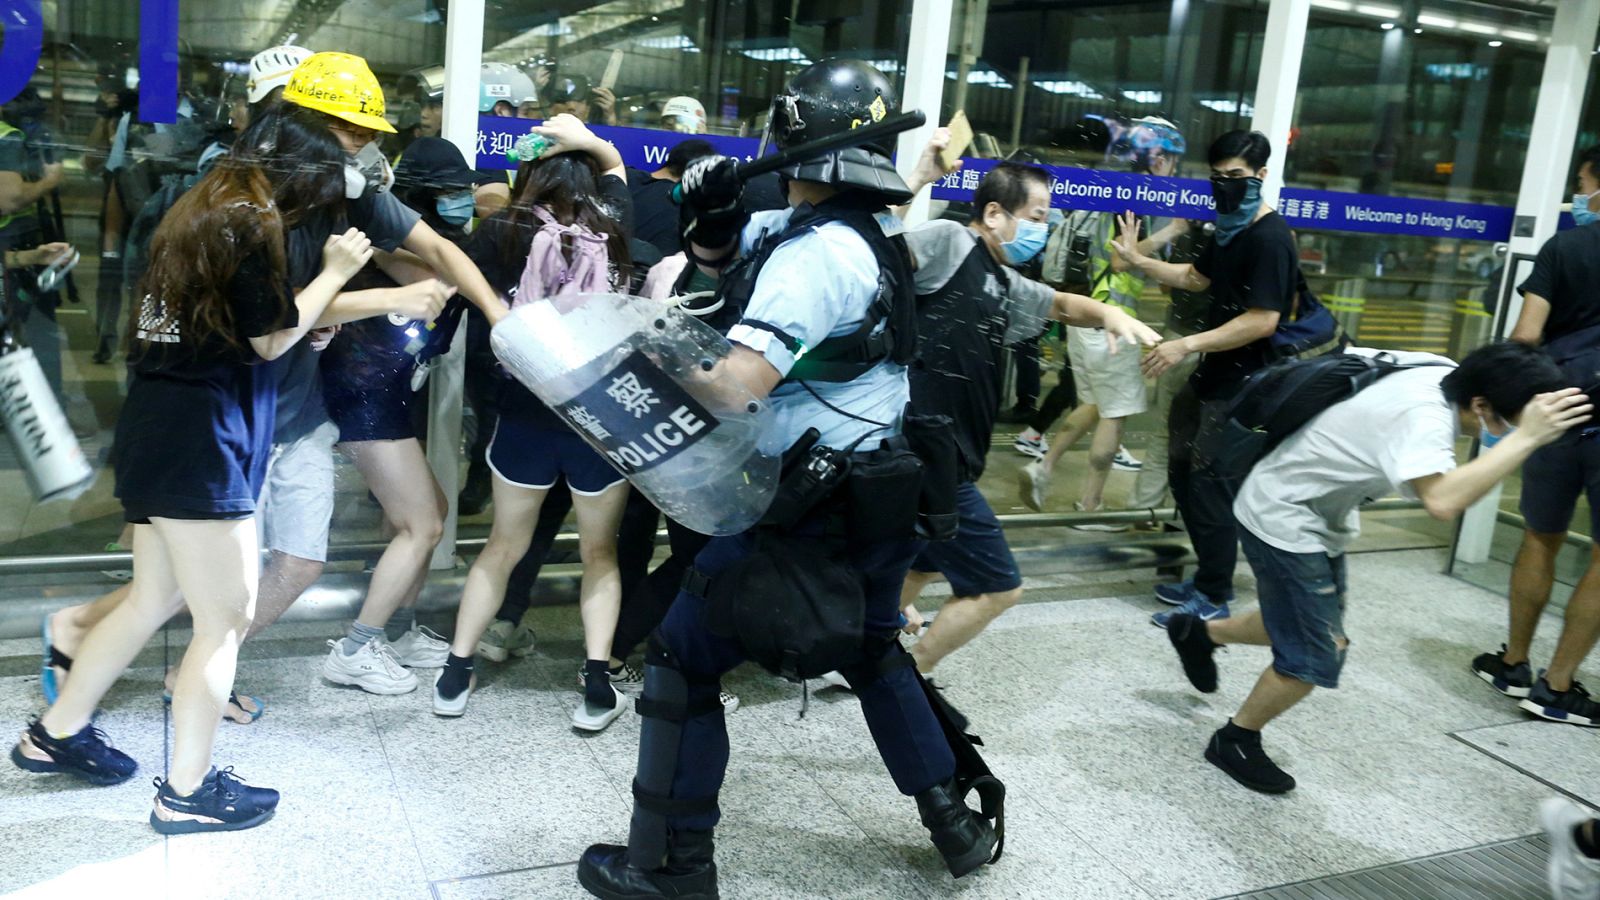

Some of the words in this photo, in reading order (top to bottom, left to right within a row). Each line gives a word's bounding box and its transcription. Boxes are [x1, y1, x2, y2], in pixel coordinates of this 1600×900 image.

[290, 77, 345, 102] Murderer
[1117, 186, 1132, 200] to
[1135, 186, 1177, 207] Hong
[1179, 189, 1217, 210] Kong
[1345, 205, 1402, 223] Welcome
[1405, 212, 1418, 225] to
[1420, 212, 1454, 231] Hong
[1455, 215, 1487, 232] Kong
[606, 405, 706, 471] POLICE
